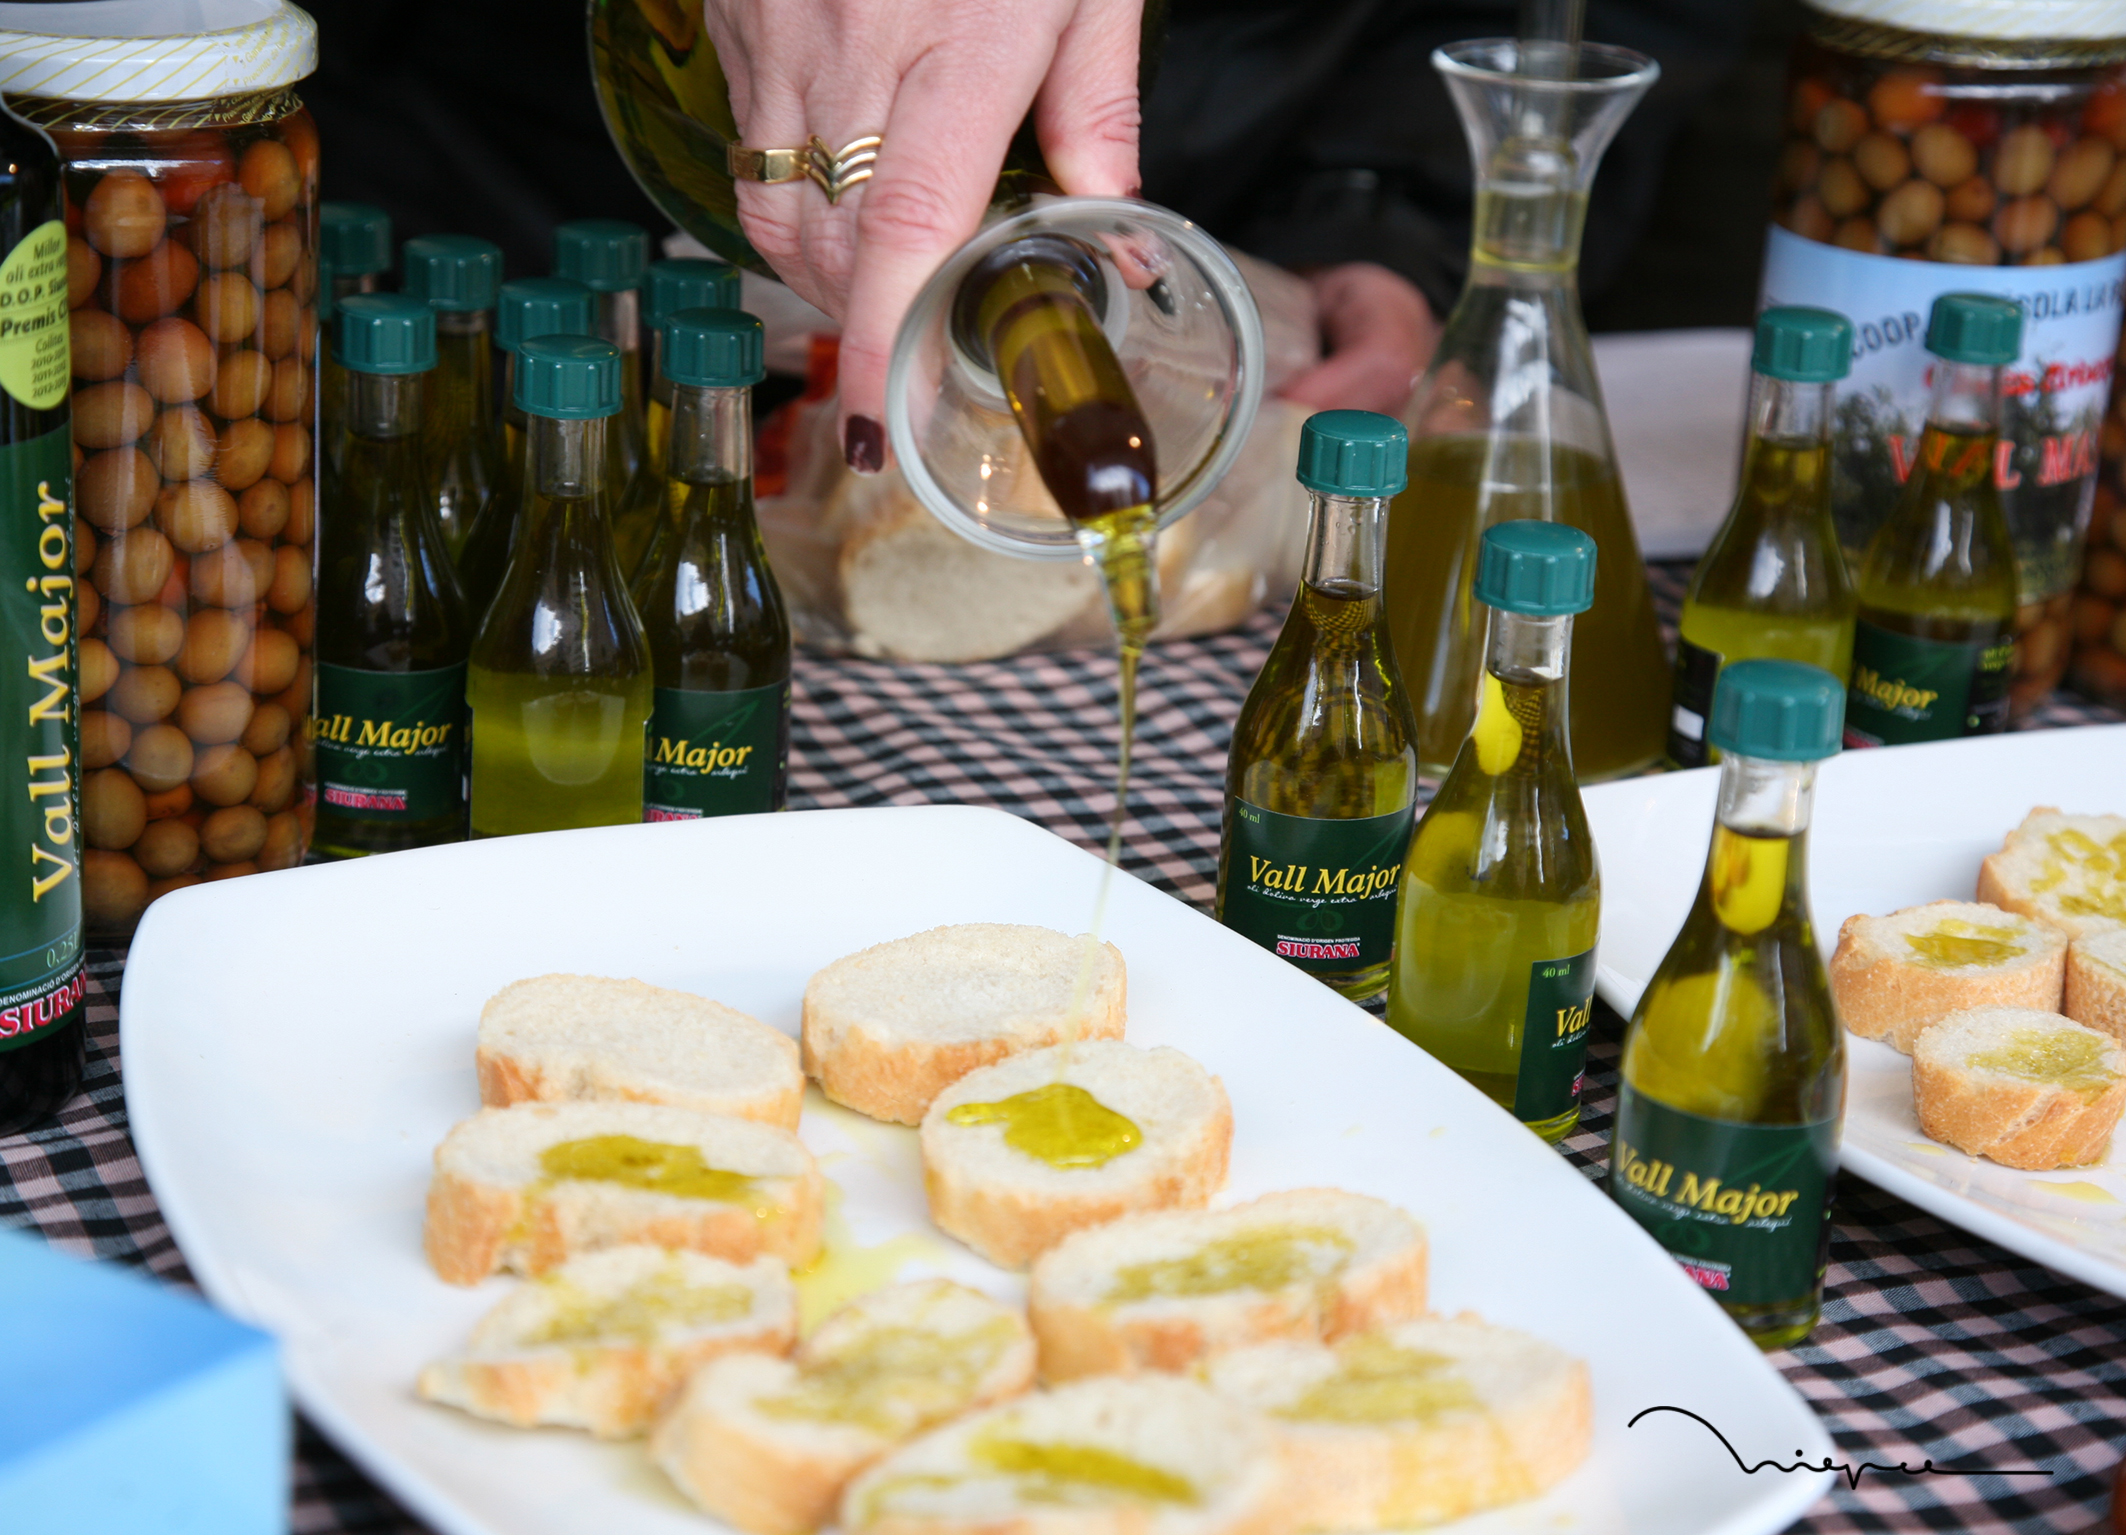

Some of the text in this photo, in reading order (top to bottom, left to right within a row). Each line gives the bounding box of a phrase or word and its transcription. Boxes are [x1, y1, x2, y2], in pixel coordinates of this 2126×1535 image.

[6, 264, 24, 284] oli
[1, 307, 56, 337] Premis
[26, 480, 74, 903] Vall Major
[1856, 665, 1938, 711] Major
[355, 720, 452, 755] Major
[654, 737, 753, 774] Major
[324, 788, 408, 811] SIURANA
[1249, 813, 1260, 824] ml
[1250, 855, 1401, 900] Vall Major
[1276, 941, 1360, 960] SIURANA
[1542, 964, 1571, 979] 40 ml
[1556, 994, 1594, 1038] Vall
[1616, 1139, 1799, 1225] Vall Major
